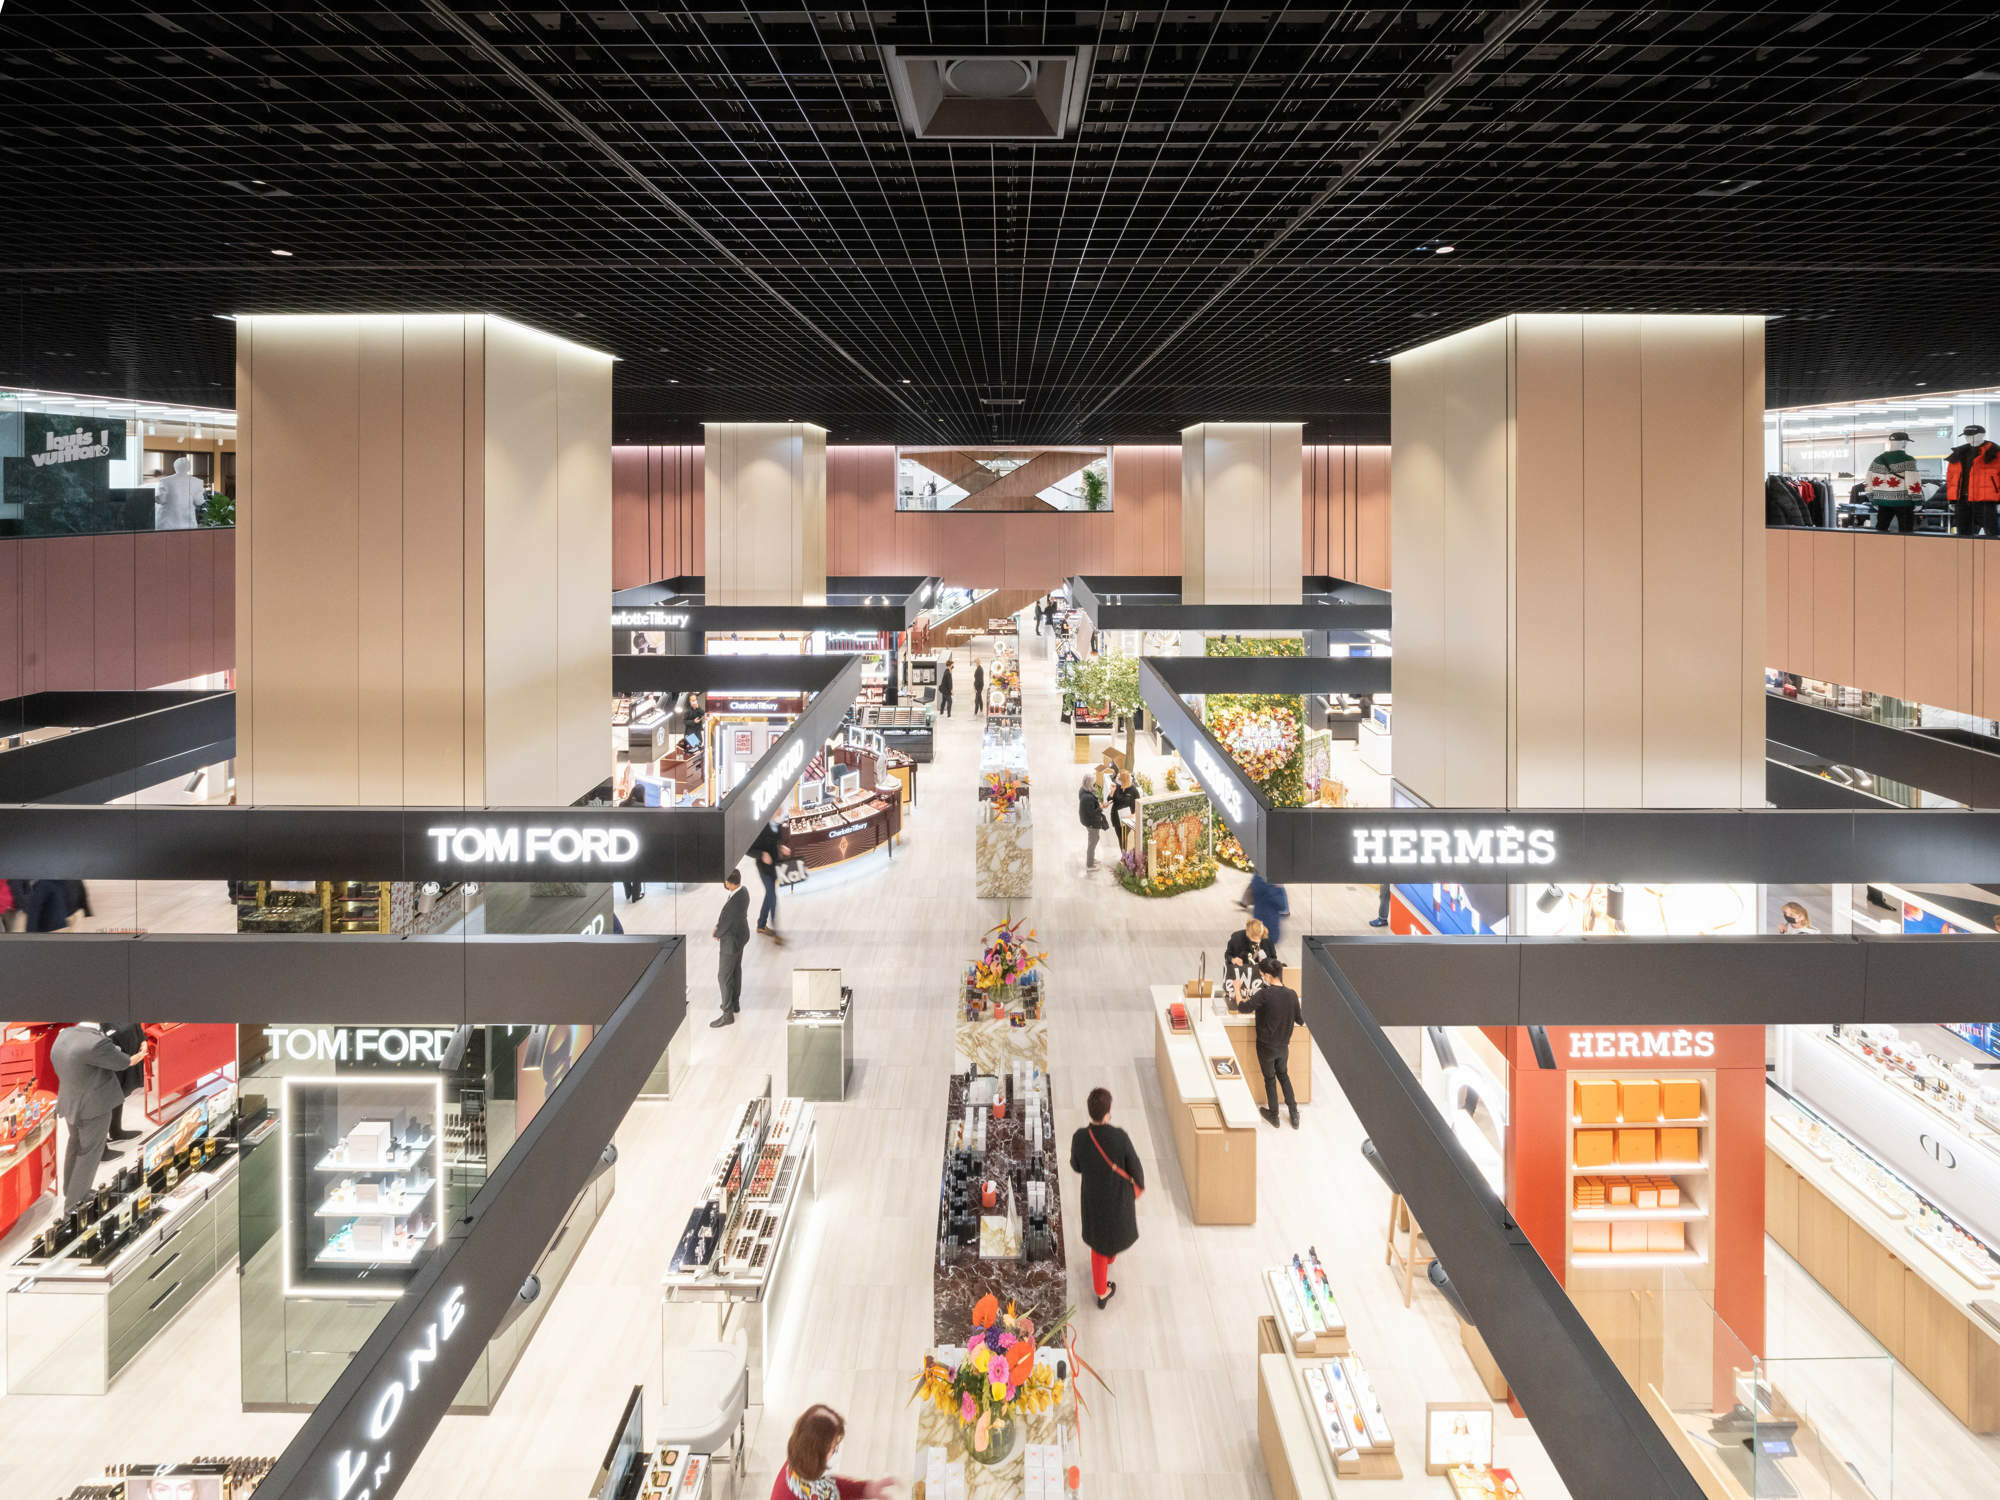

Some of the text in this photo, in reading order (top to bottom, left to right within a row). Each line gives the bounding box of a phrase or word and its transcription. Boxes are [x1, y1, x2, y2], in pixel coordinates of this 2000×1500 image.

[46, 427, 94, 451] louis
[427, 827, 640, 863] TOM FORD
[1352, 824, 1557, 865] HERMÈS
[262, 1028, 455, 1062] TOM FORD
[1569, 1029, 1715, 1058] HERMÈS
